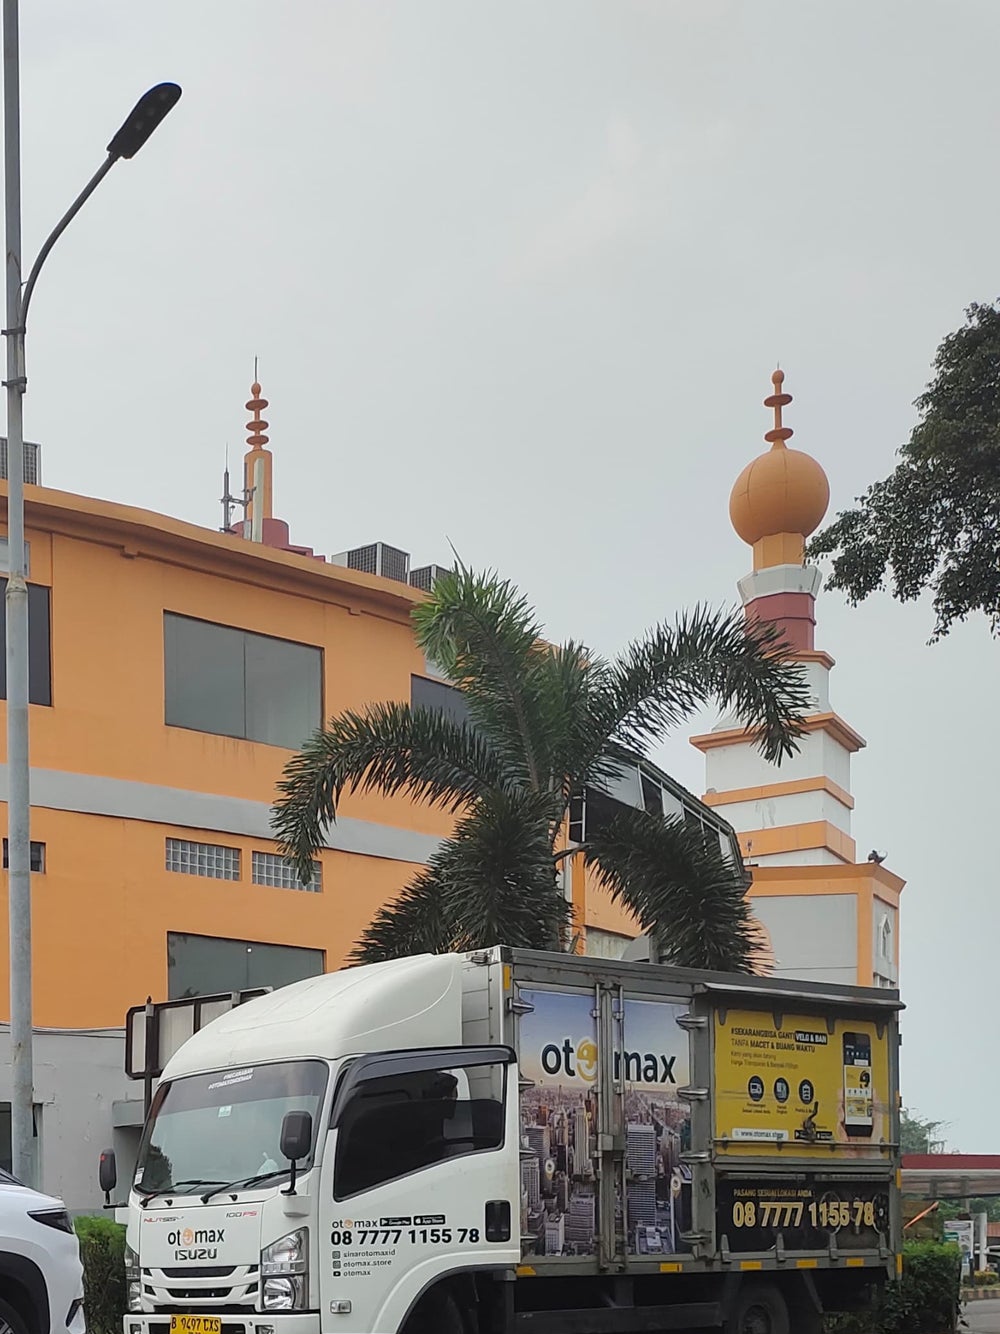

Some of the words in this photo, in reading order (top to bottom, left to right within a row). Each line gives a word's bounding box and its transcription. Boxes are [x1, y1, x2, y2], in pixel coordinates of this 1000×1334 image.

[732, 1201, 757, 1228] 08
[759, 1201, 804, 1228] 7777
[808, 1201, 850, 1228] 1155
[853, 1201, 875, 1228] 78
[330, 1230, 353, 1246] 08
[357, 1229, 402, 1245] 7777
[408, 1228, 452, 1244] 1155
[457, 1228, 480, 1244] 78
[175, 1248, 218, 1261] ISUZU
[171, 1316, 177, 1330] B
